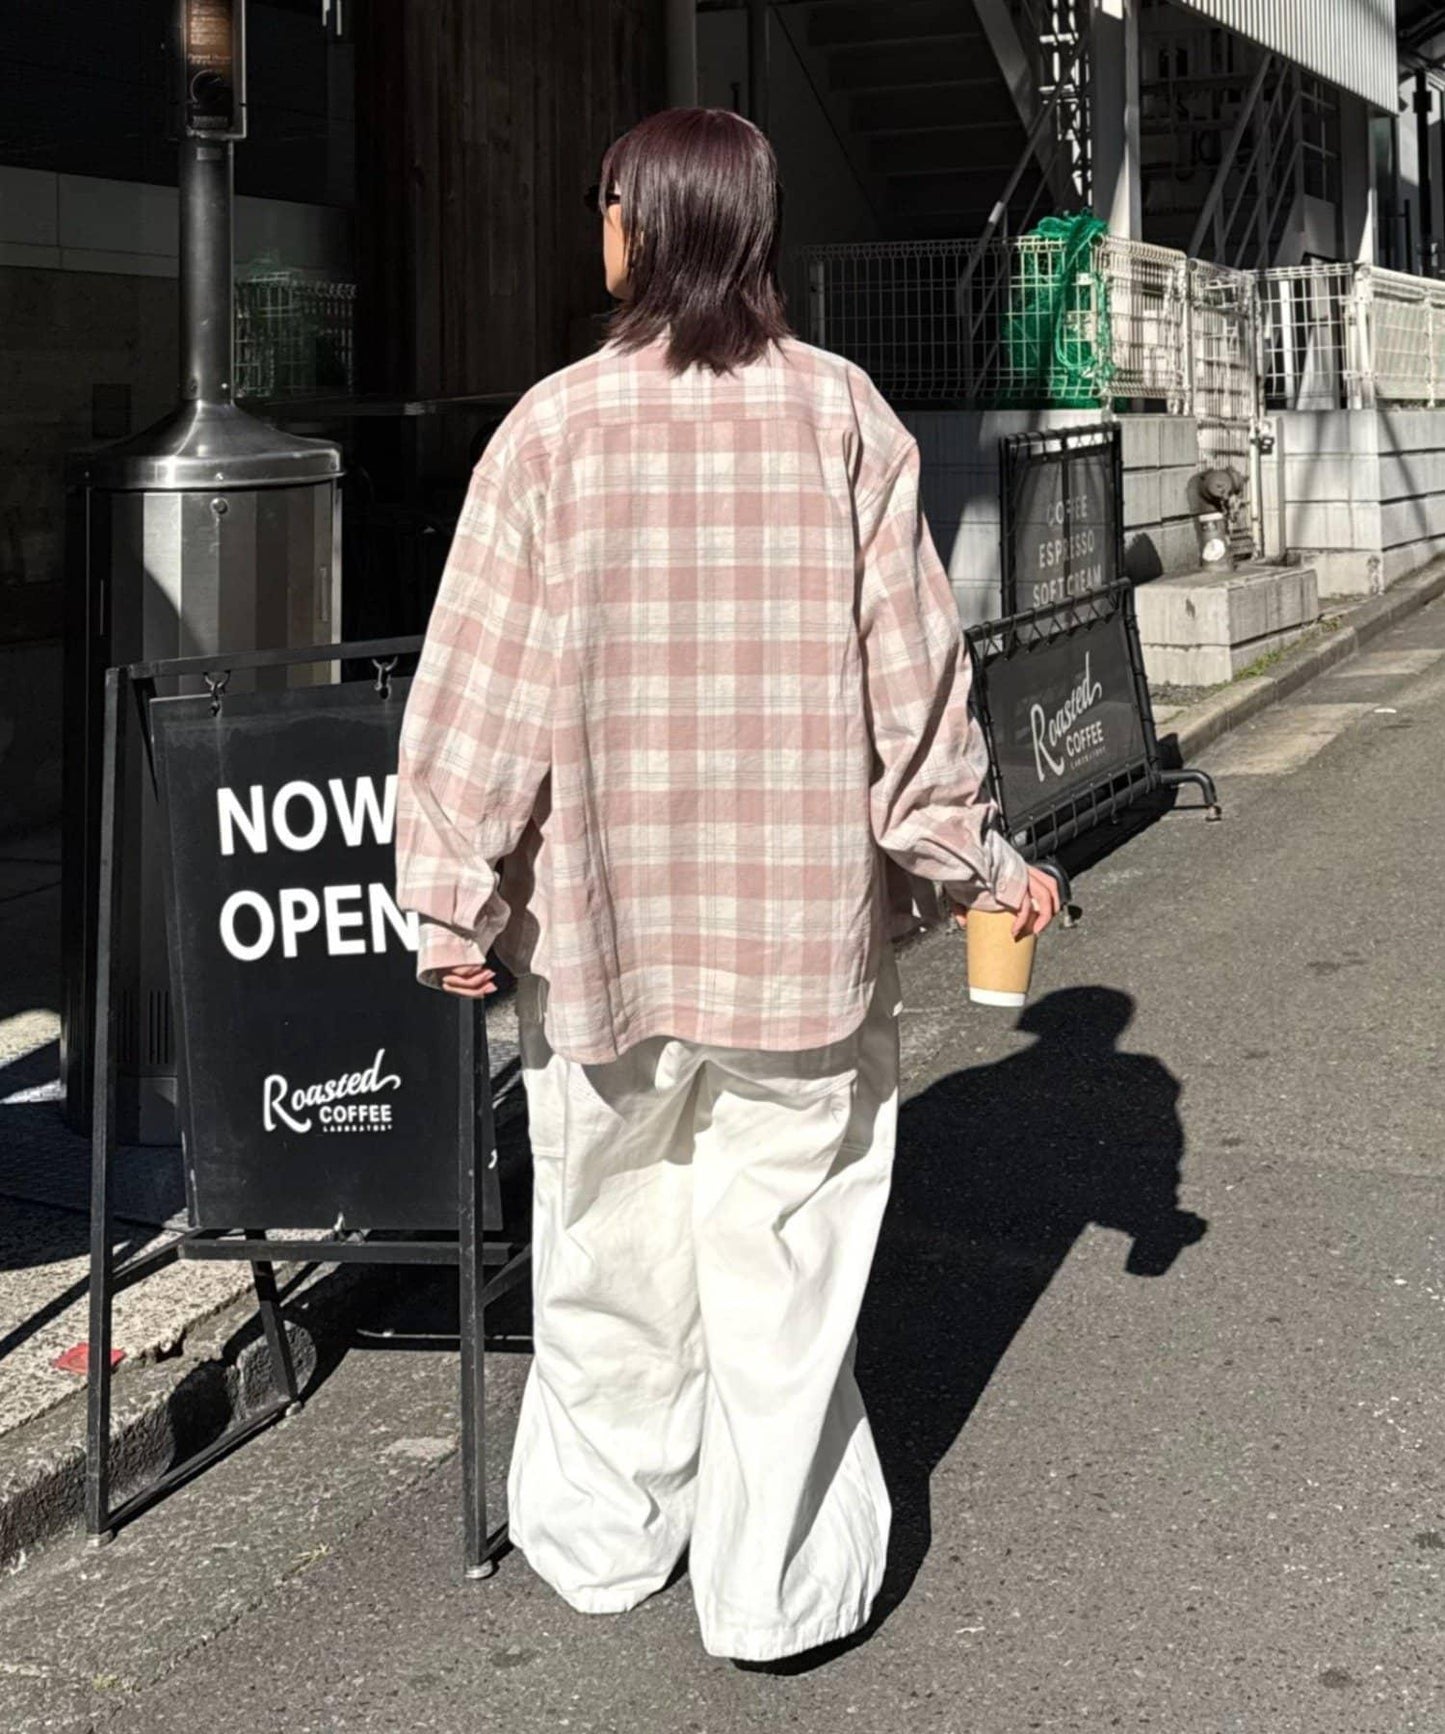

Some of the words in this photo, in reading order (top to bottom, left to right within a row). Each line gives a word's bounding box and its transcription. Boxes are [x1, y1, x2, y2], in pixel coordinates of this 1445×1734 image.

[1046, 495, 1088, 527] COEE
[1033, 577, 1065, 608] SOFT
[1030, 650, 1103, 782] Roasted
[1065, 720, 1104, 757] COFFEE
[217, 774, 398, 856] NOW
[219, 882, 420, 962] OPEN
[263, 1047, 402, 1133] Roasted
[319, 1104, 392, 1123] COFFEE
